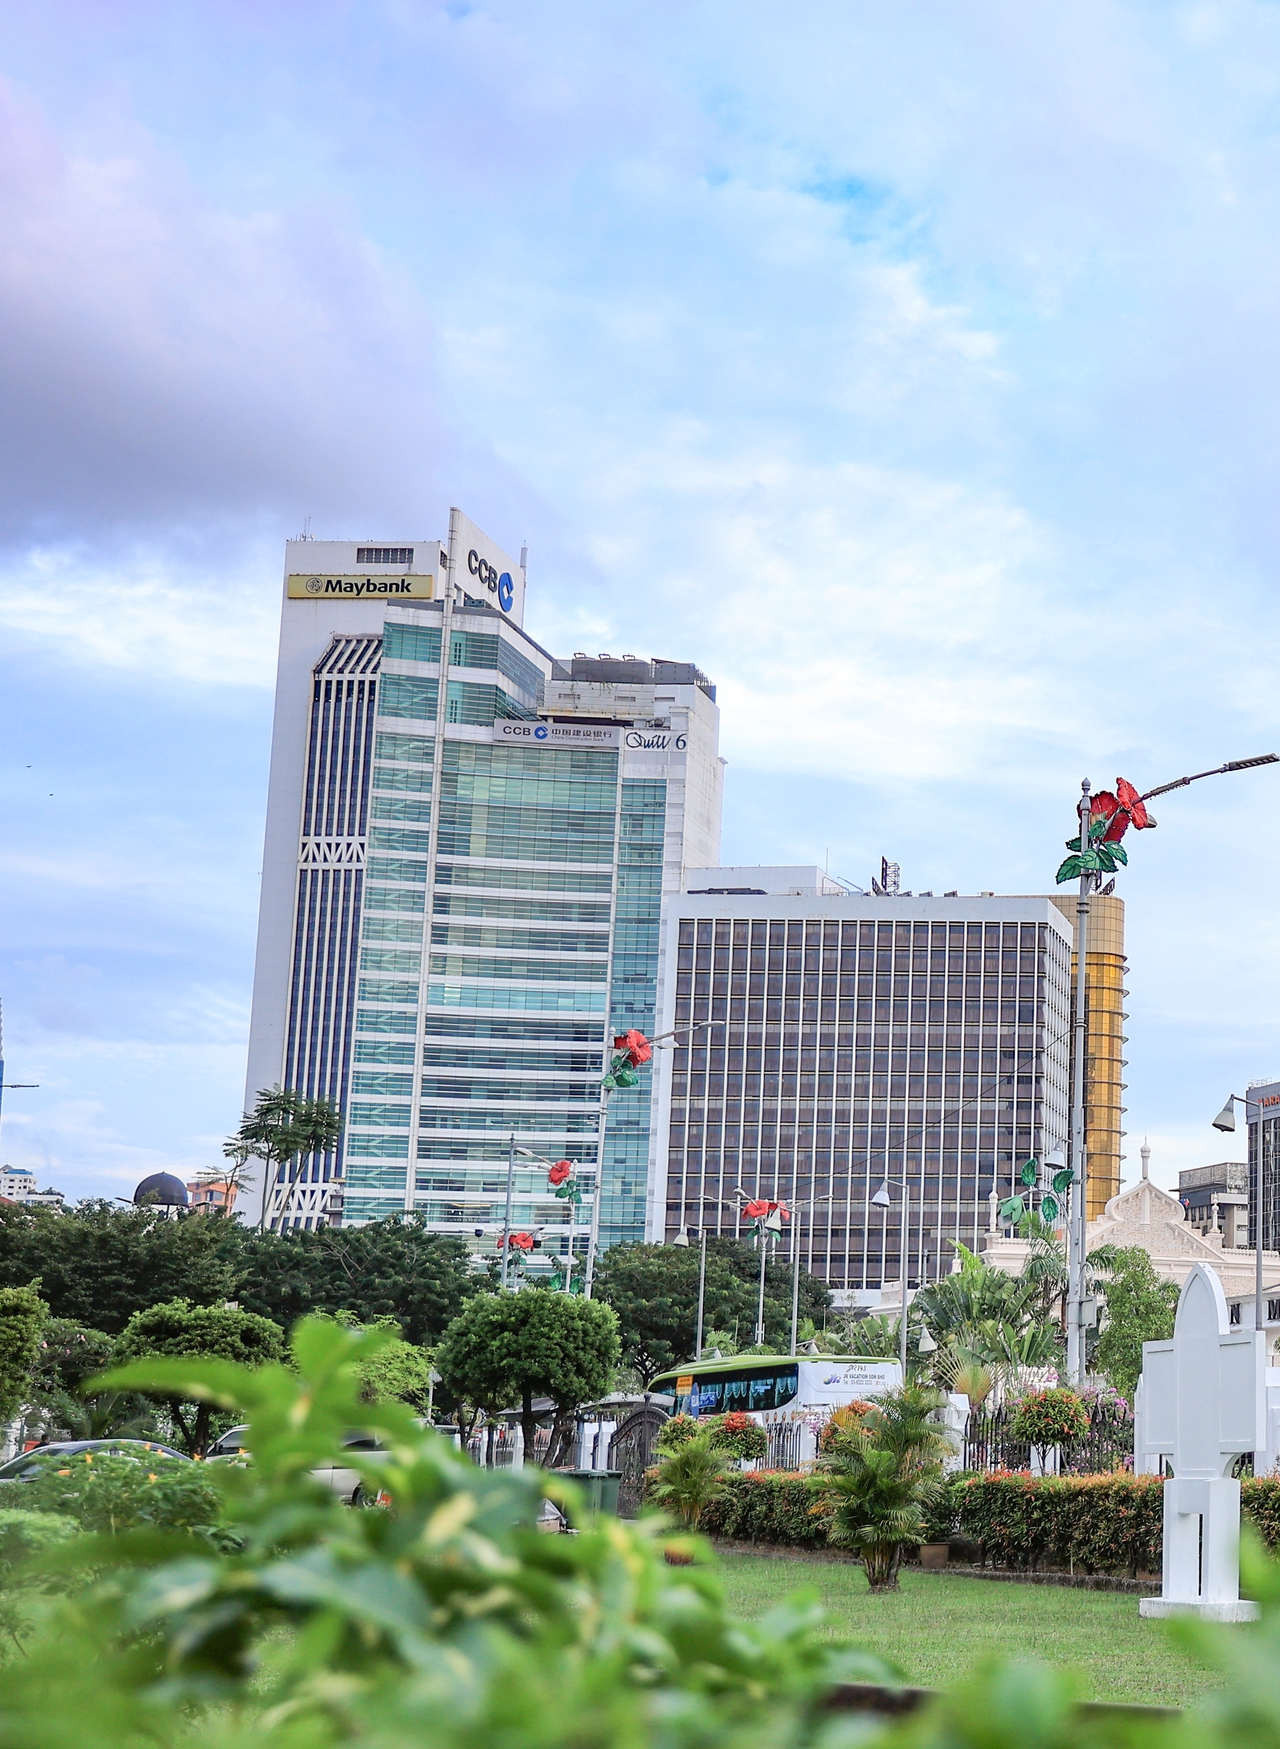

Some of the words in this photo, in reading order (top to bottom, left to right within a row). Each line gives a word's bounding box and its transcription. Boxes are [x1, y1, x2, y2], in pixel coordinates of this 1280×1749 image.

[468, 549, 498, 593] CCB
[324, 578, 412, 596] Maybank
[502, 726, 531, 736] CCB
[551, 728, 612, 738] 中国建设银行
[625, 731, 672, 750] Quill
[675, 733, 687, 750] 6
